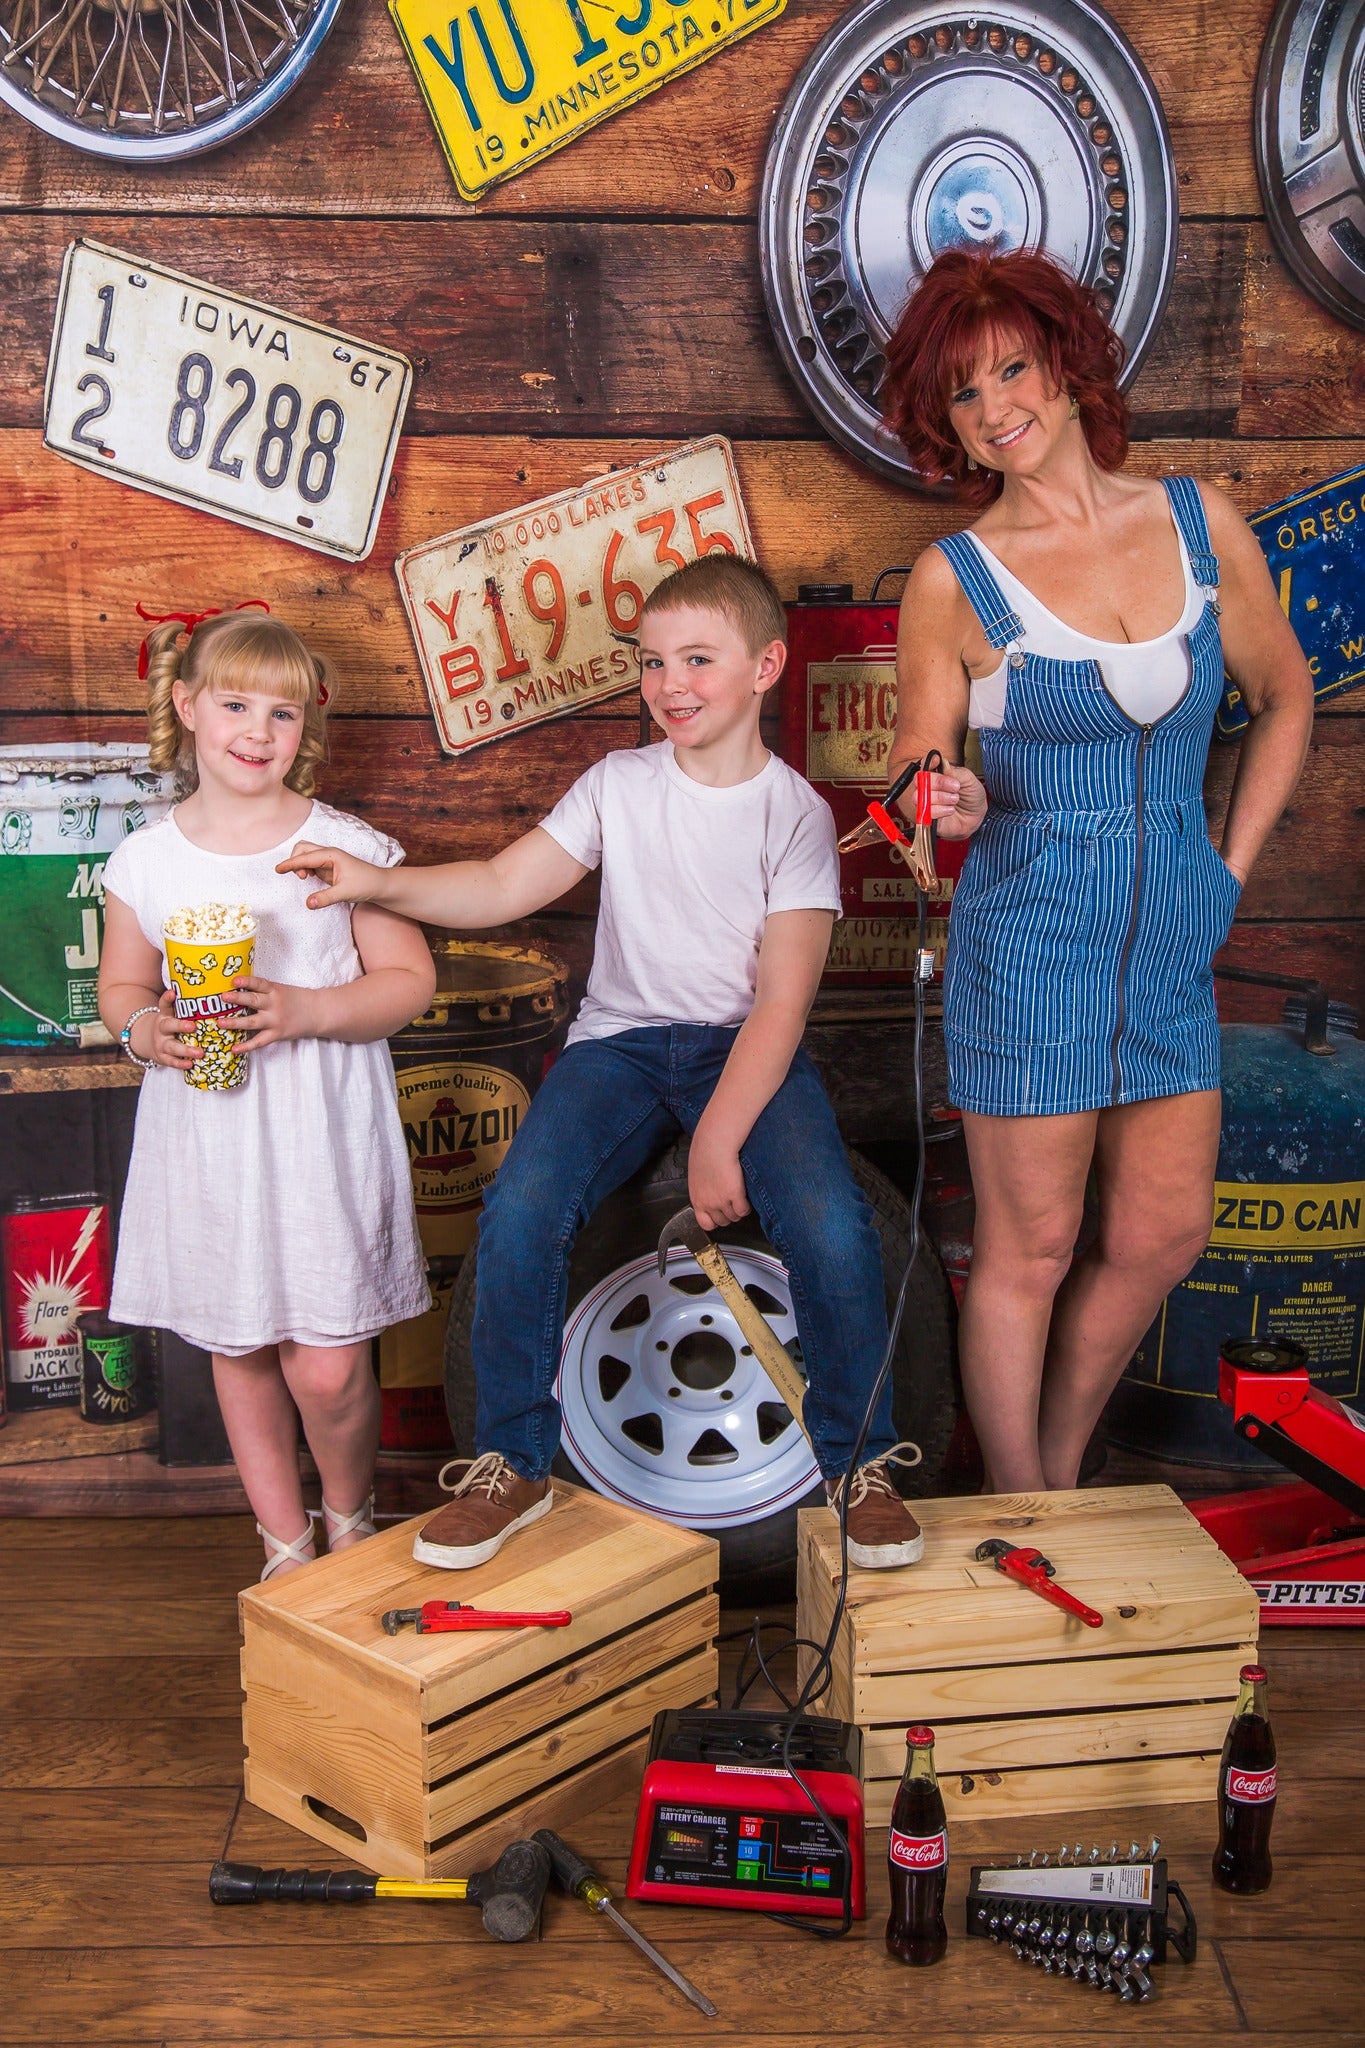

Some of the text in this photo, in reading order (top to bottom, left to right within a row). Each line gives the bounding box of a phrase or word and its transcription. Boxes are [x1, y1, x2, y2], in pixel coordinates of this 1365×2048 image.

[423, 0, 536, 132] YU
[474, 134, 505, 171] 19
[523, 15, 704, 140] MINNESOTA
[179, 295, 393, 393] IOWA 67
[167, 352, 344, 503] 8288
[566, 479, 648, 526] LAKES
[464, 699, 493, 730] 19
[873, 882, 905, 898] S.A.E.
[397, 1073, 502, 1100] upreme Quality
[1294, 1197, 1361, 1232] CAN
[1274, 1255, 1289, 1263] 18.9
[1290, 1255, 1314, 1263] LITERS
[1218, 1284, 1240, 1294] STEEL
[1302, 1282, 1333, 1293] DANGER
[34, 1301, 69, 1324] Flare
[1268, 1307, 1295, 1316] HARMFUL
[1295, 1308, 1304, 1316] OR
[1304, 1307, 1321, 1316] FATAL
[24, 1359, 69, 1380] JACK
[660, 1812, 727, 1826] BATTERY CHARGER
[745, 1823, 756, 1834] 50
[744, 1846, 753, 1855] 10
[893, 1840, 942, 1862] Coca-Cola
[745, 1867, 751, 1875] 2
